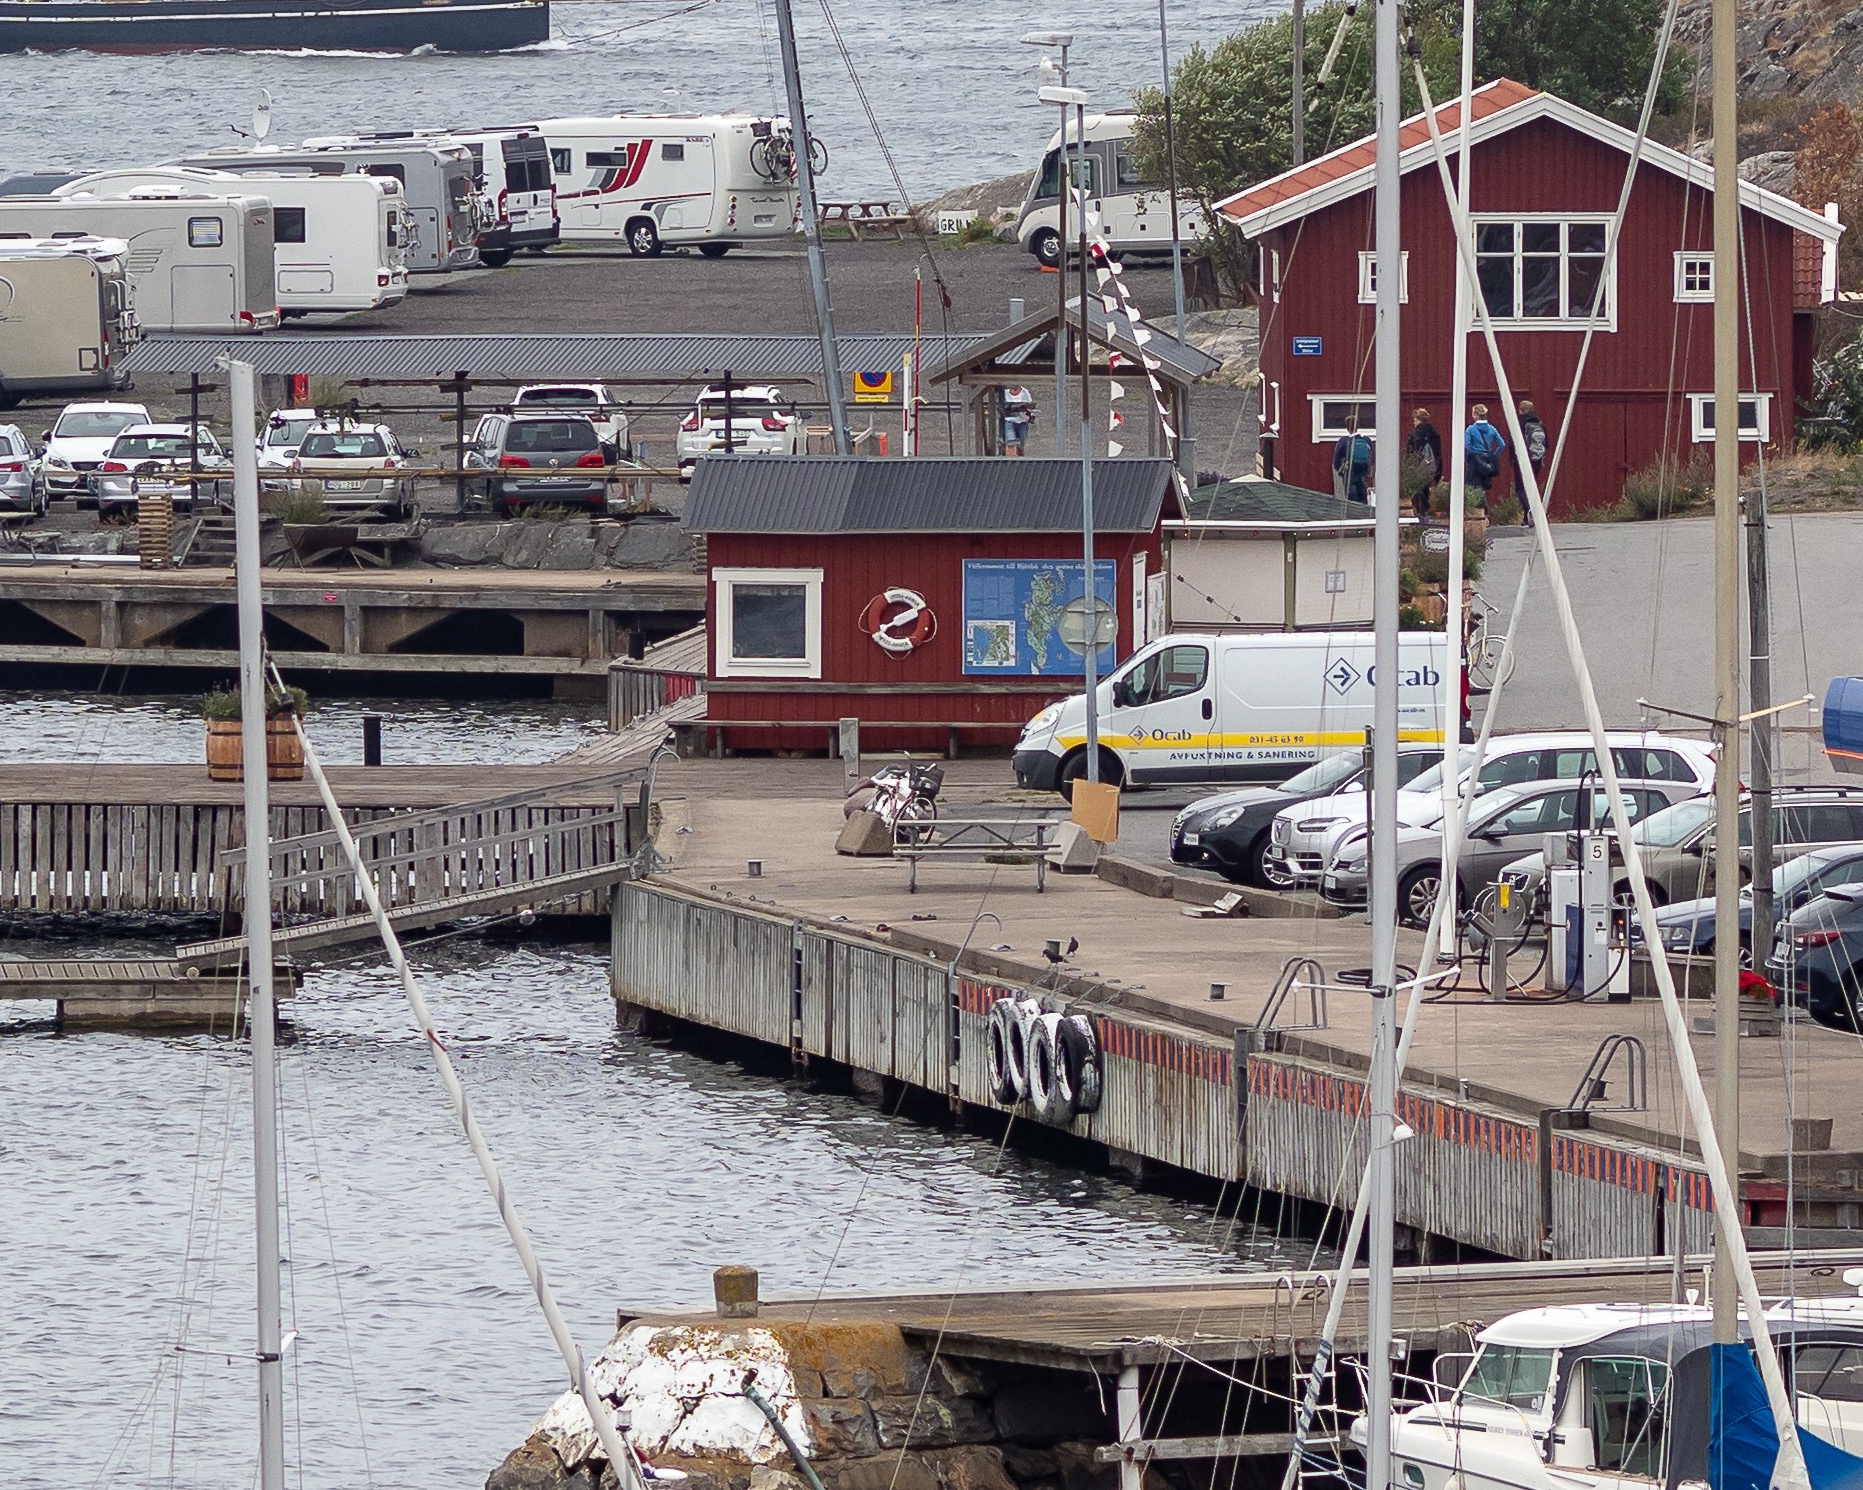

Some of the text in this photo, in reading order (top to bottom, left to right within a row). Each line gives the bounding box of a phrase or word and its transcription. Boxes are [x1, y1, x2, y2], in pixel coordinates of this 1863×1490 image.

[1152, 729, 1192, 741] Ocab
[1169, 749, 1315, 761] AVFUKTNING & SANERING
[1592, 845, 1603, 859] 5
